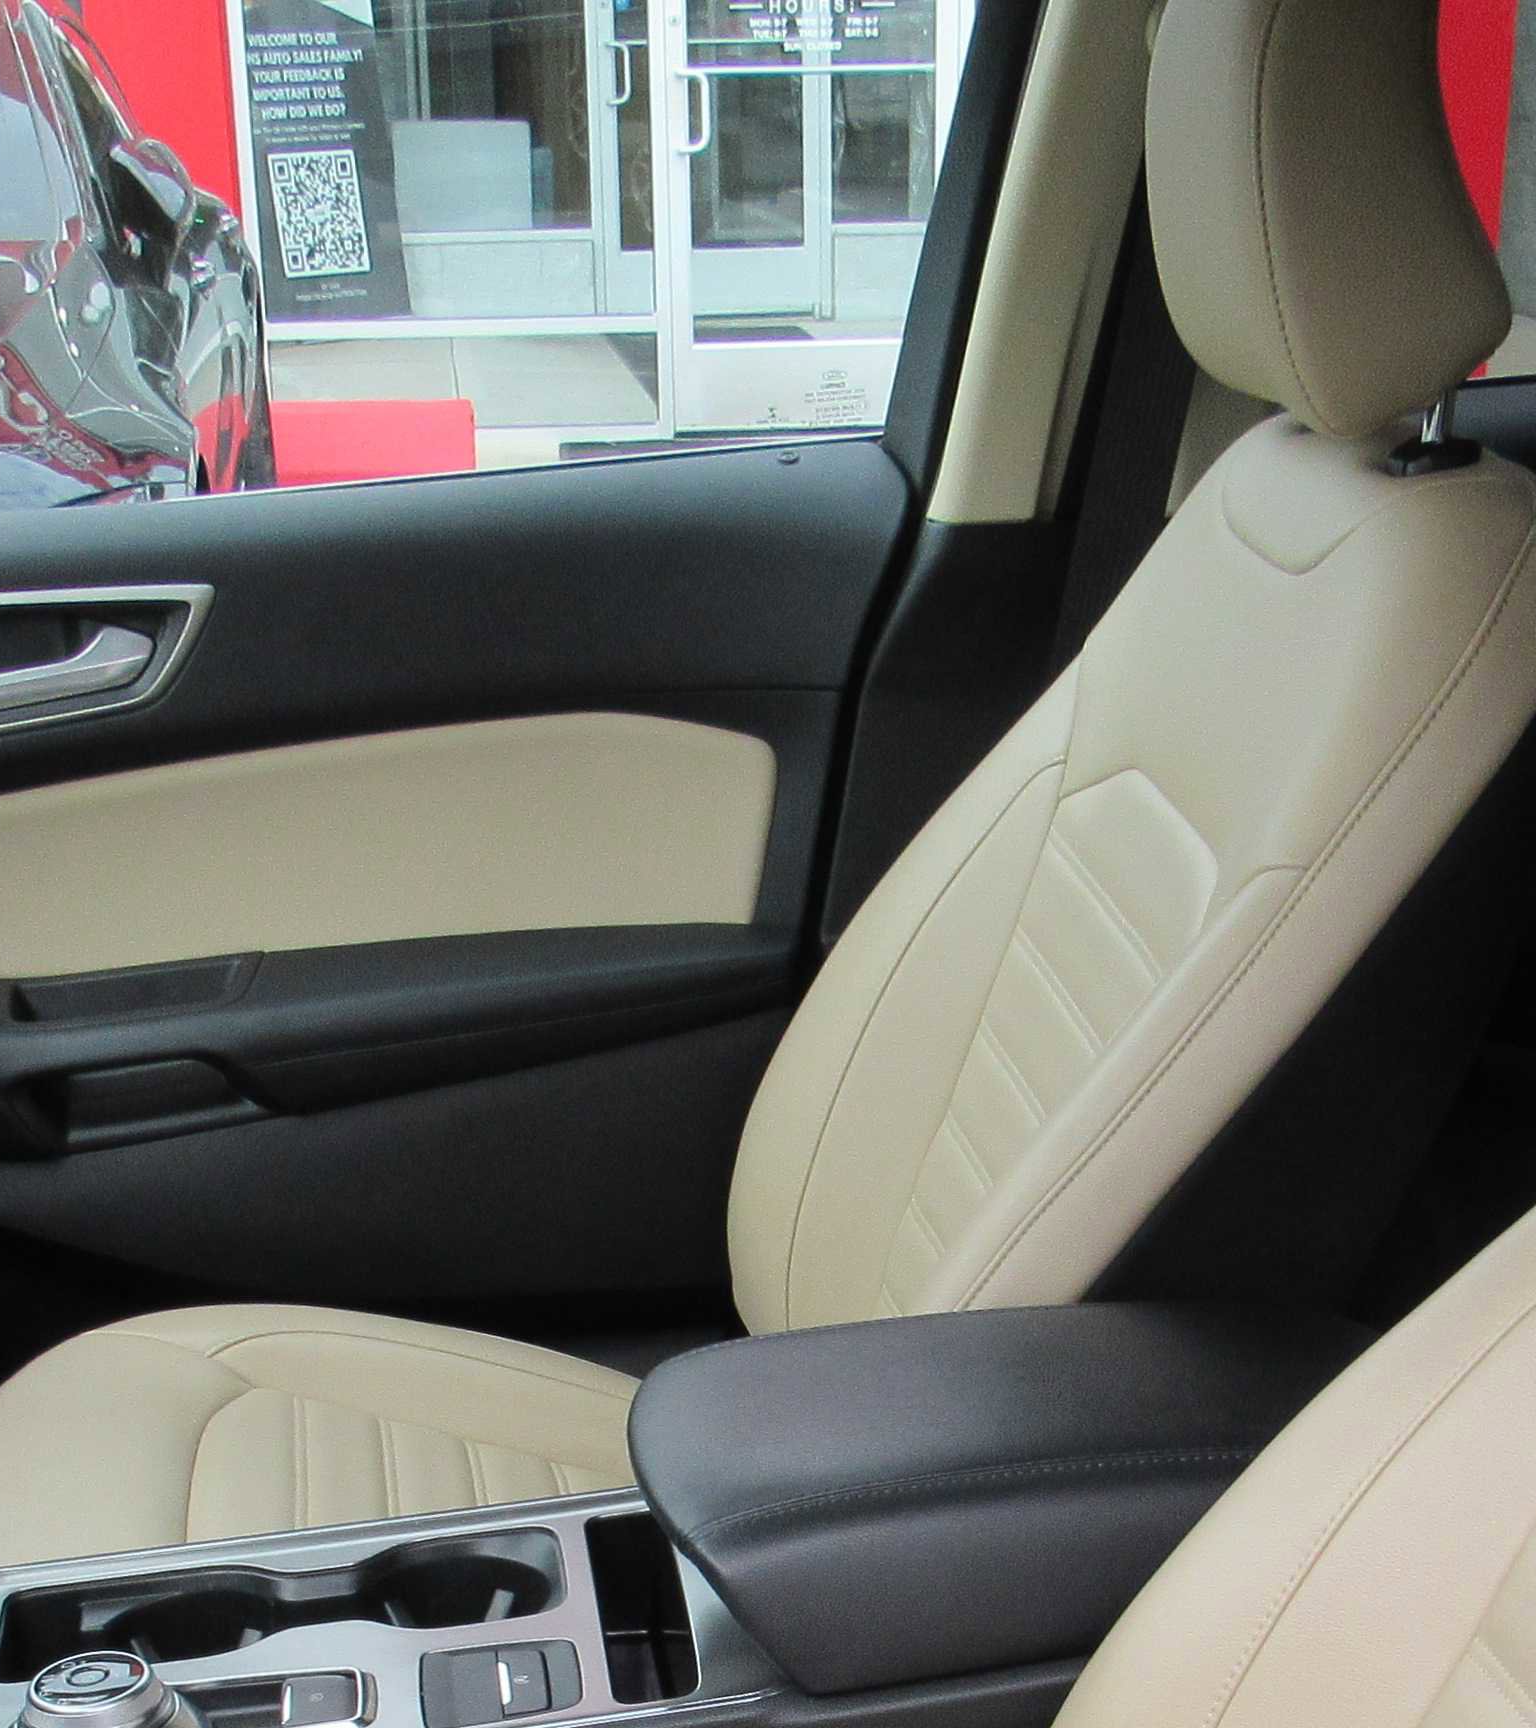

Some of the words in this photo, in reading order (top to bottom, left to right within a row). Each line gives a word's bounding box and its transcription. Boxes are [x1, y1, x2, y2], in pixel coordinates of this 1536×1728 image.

[247, 33, 297, 47] WELCOME
[299, 32, 313, 45] TO
[314, 31, 337, 45] OUR
[263, 51, 291, 65] AUTO
[293, 49, 322, 63] SALES
[252, 69, 282, 83] YOUR
[283, 67, 333, 81] FEEDBACK
[334, 66, 345, 80] IS
[252, 87, 310, 101] IMPORTANT
[311, 86, 326, 99] TO
[261, 104, 288, 119] HOW
[289, 104, 306, 118] DID
[307, 103, 323, 117] WE
